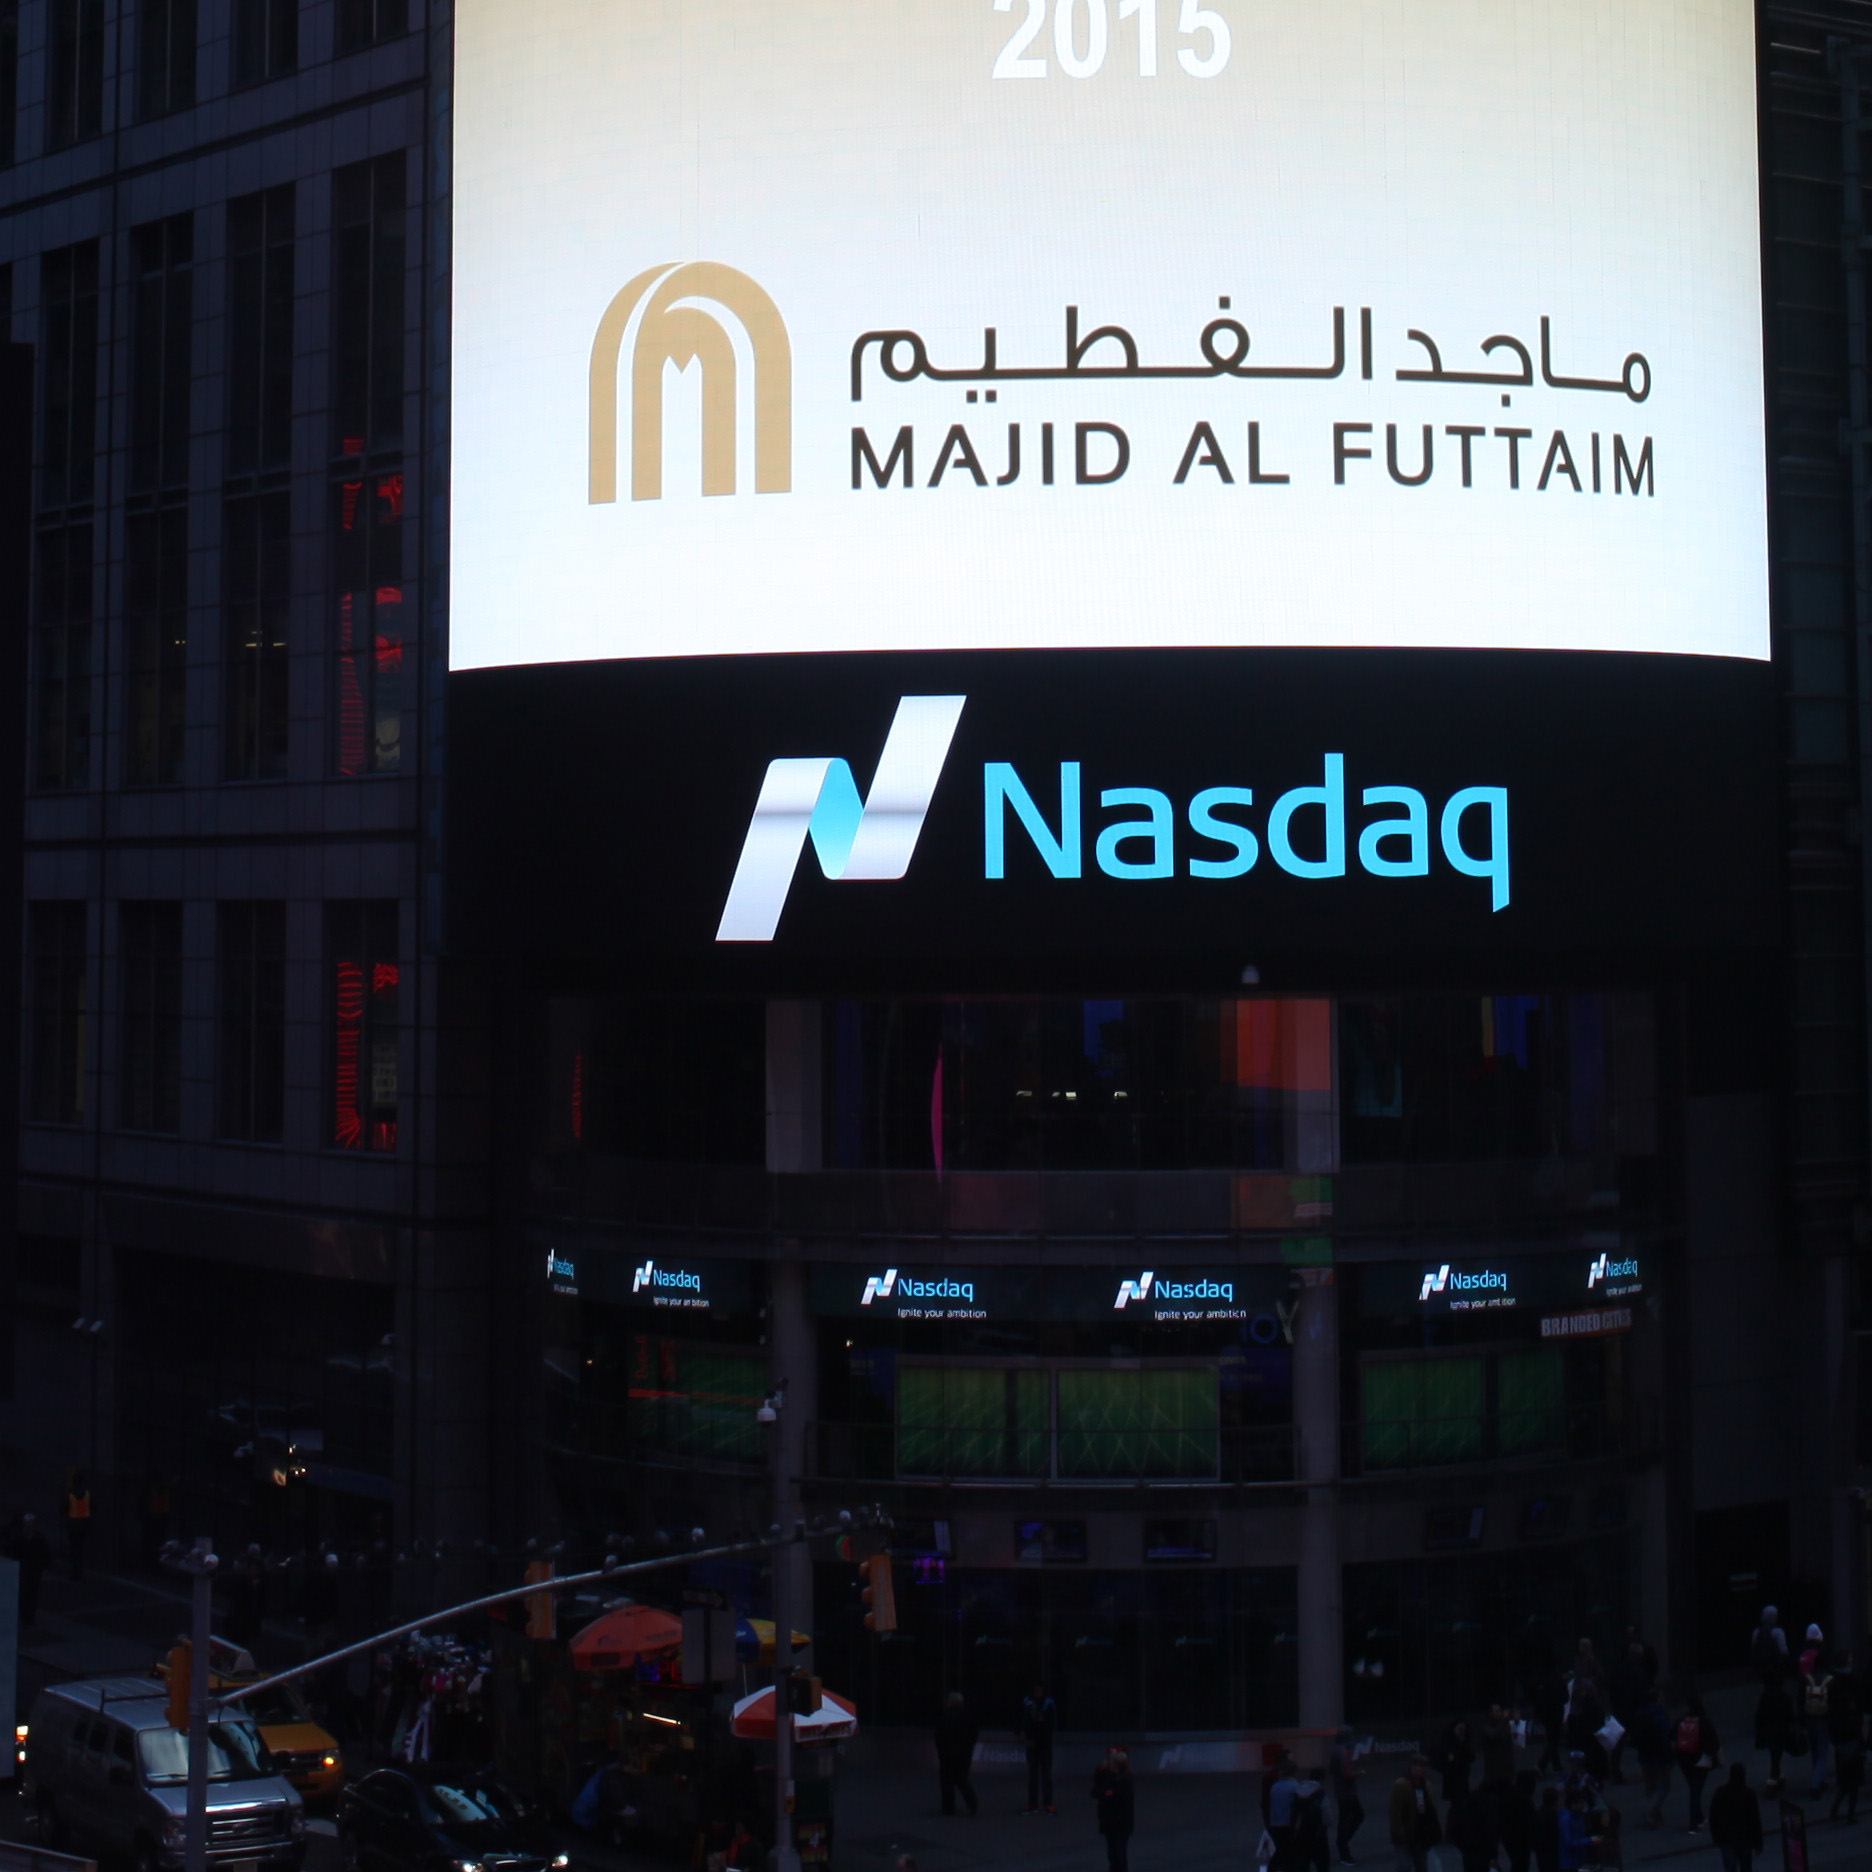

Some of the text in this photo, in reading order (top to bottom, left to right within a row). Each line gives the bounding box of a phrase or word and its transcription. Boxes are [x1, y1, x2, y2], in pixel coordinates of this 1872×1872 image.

[850, 420, 1655, 498] MAJID AL FUTTAIM
[984, 752, 1510, 913] Nasdaq
[652, 1269, 701, 1293] Nasdaq
[897, 1278, 975, 1303] Nasdaq
[1154, 1278, 1233, 1302] Nasdaq
[1450, 1269, 1507, 1292] Nasdaq
[898, 1307, 987, 1320] Ignite your ambition
[1154, 1309, 1180, 1321] Ignite
[1182, 1311, 1203, 1321] your
[1541, 1313, 1601, 1338] BRANDED
